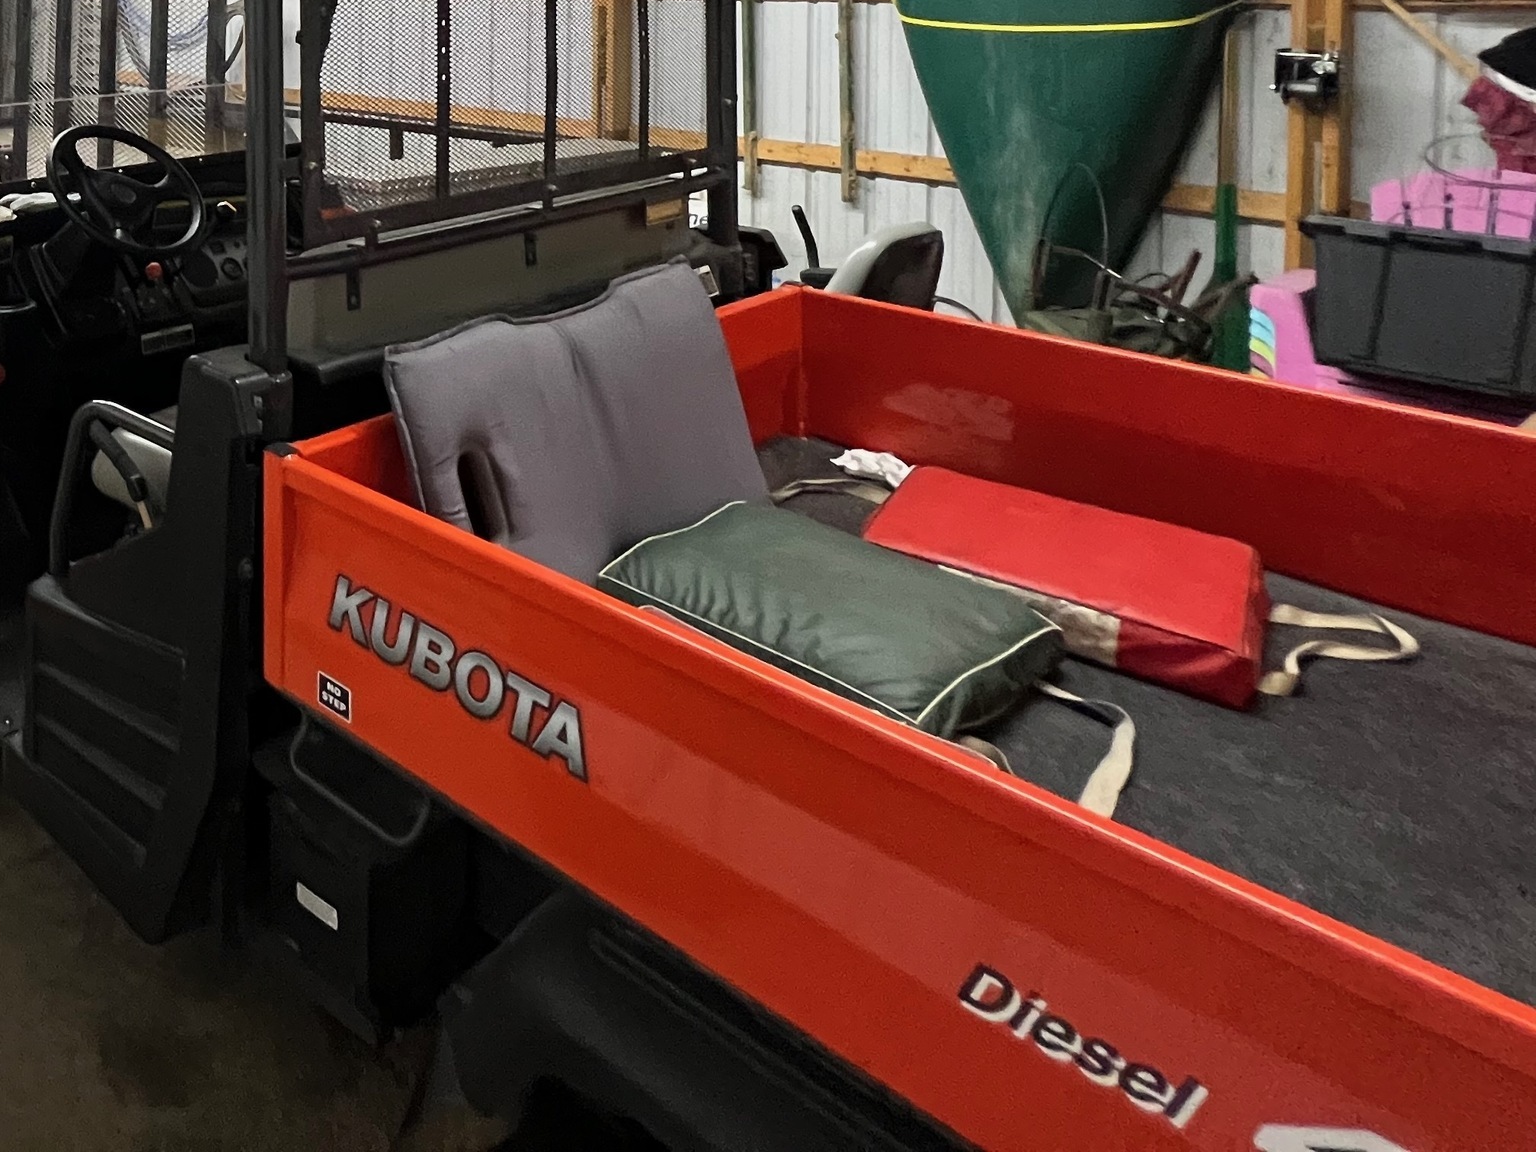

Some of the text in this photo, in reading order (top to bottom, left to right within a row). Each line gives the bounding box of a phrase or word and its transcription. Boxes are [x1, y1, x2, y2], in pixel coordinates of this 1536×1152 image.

[321, 690, 347, 711] STEP
[326, 681, 342, 697] NO
[328, 572, 589, 784] KUBOTA
[957, 962, 1210, 1130] Diesel
